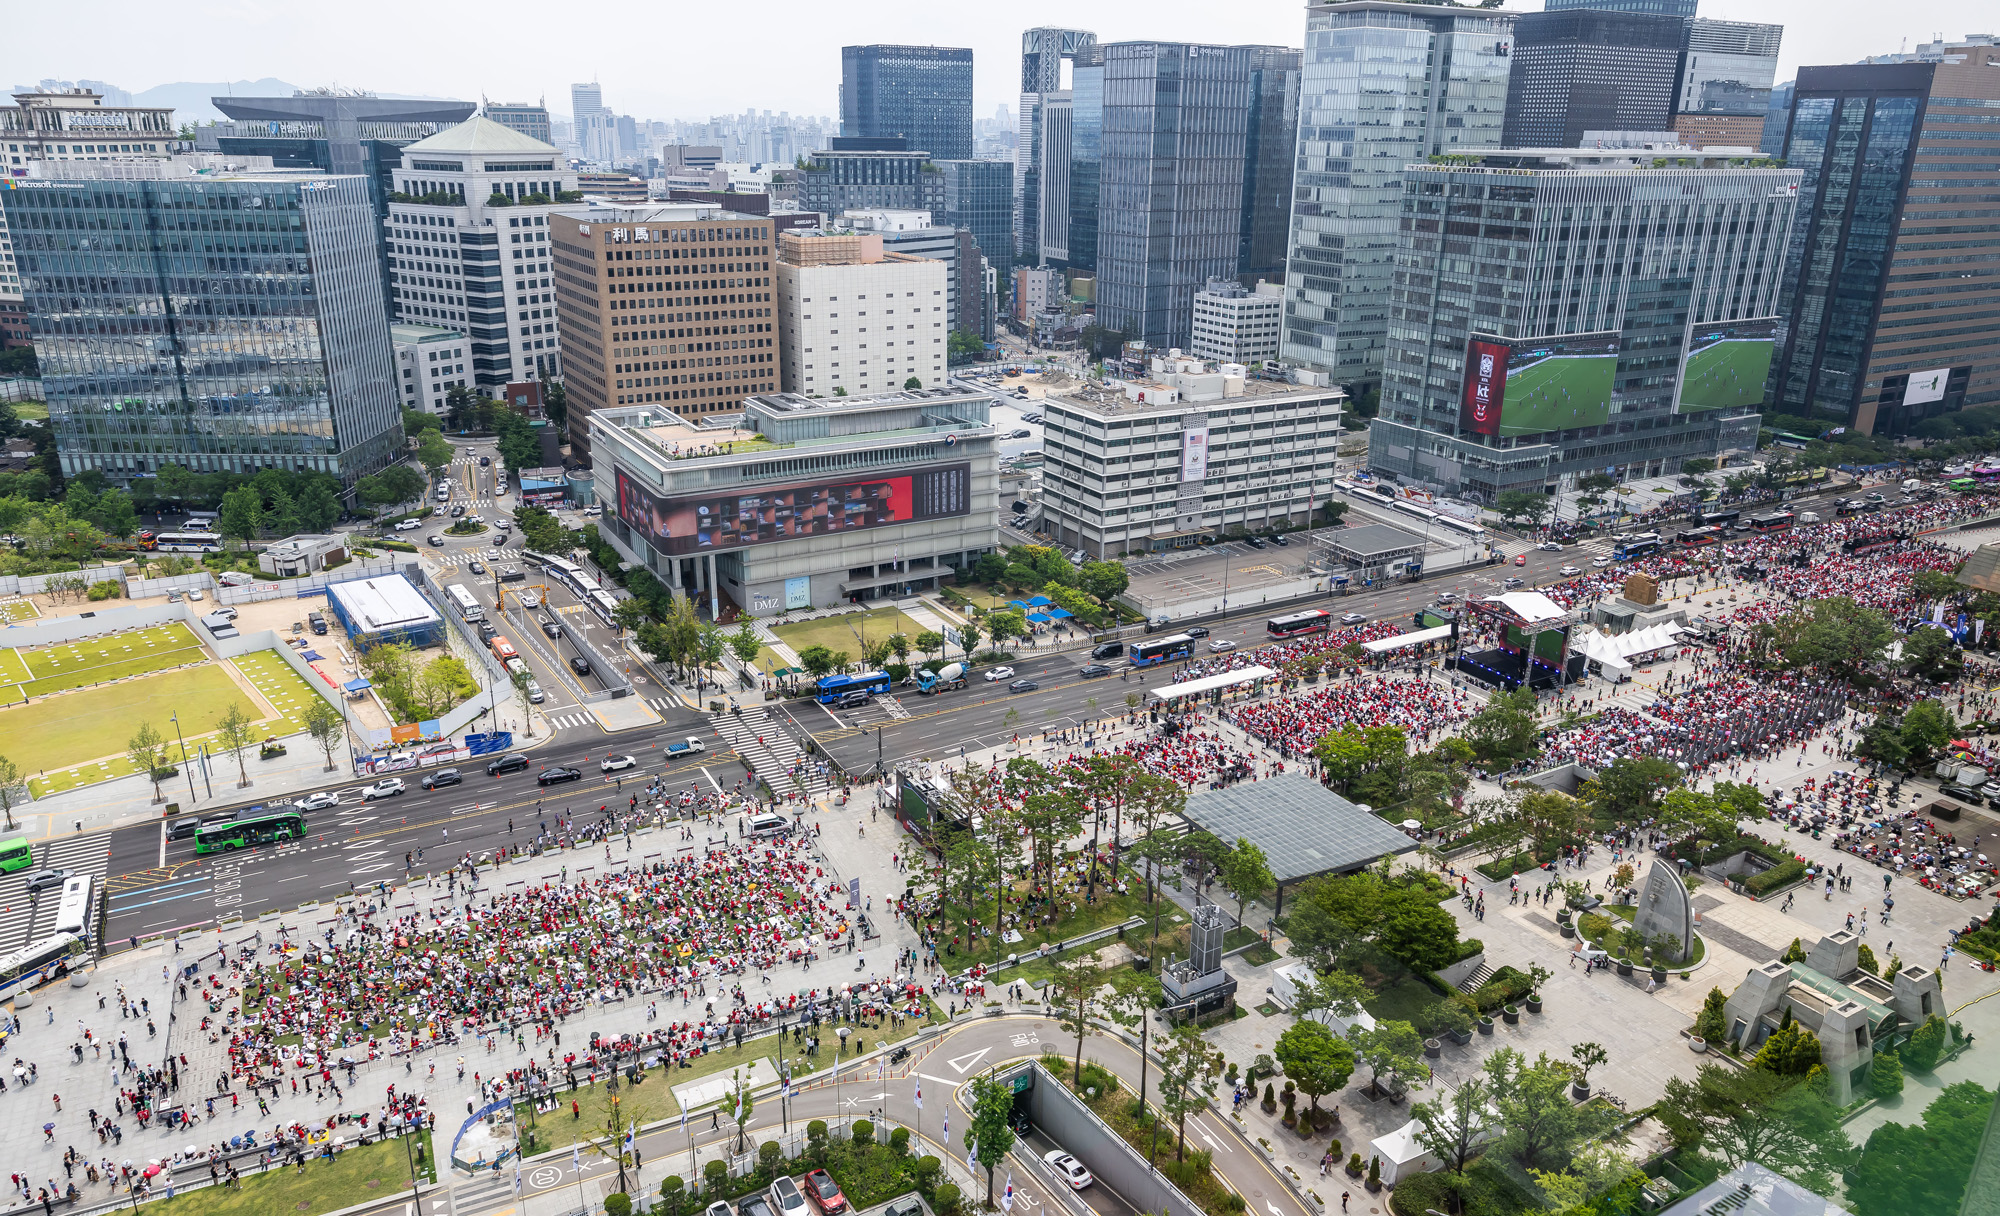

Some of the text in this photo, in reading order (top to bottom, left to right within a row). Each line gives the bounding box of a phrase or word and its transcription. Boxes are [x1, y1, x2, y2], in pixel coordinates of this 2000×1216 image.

[69, 116, 124, 126] SOMERSET
[612, 227, 649, 241] 利馬
[1477, 384, 1489, 398] kt
[754, 598, 779, 610] DMZ
[789, 594, 806, 603] DMZ
[536, 1170, 554, 1185] 20
[1012, 1188, 1039, 1210] 30
